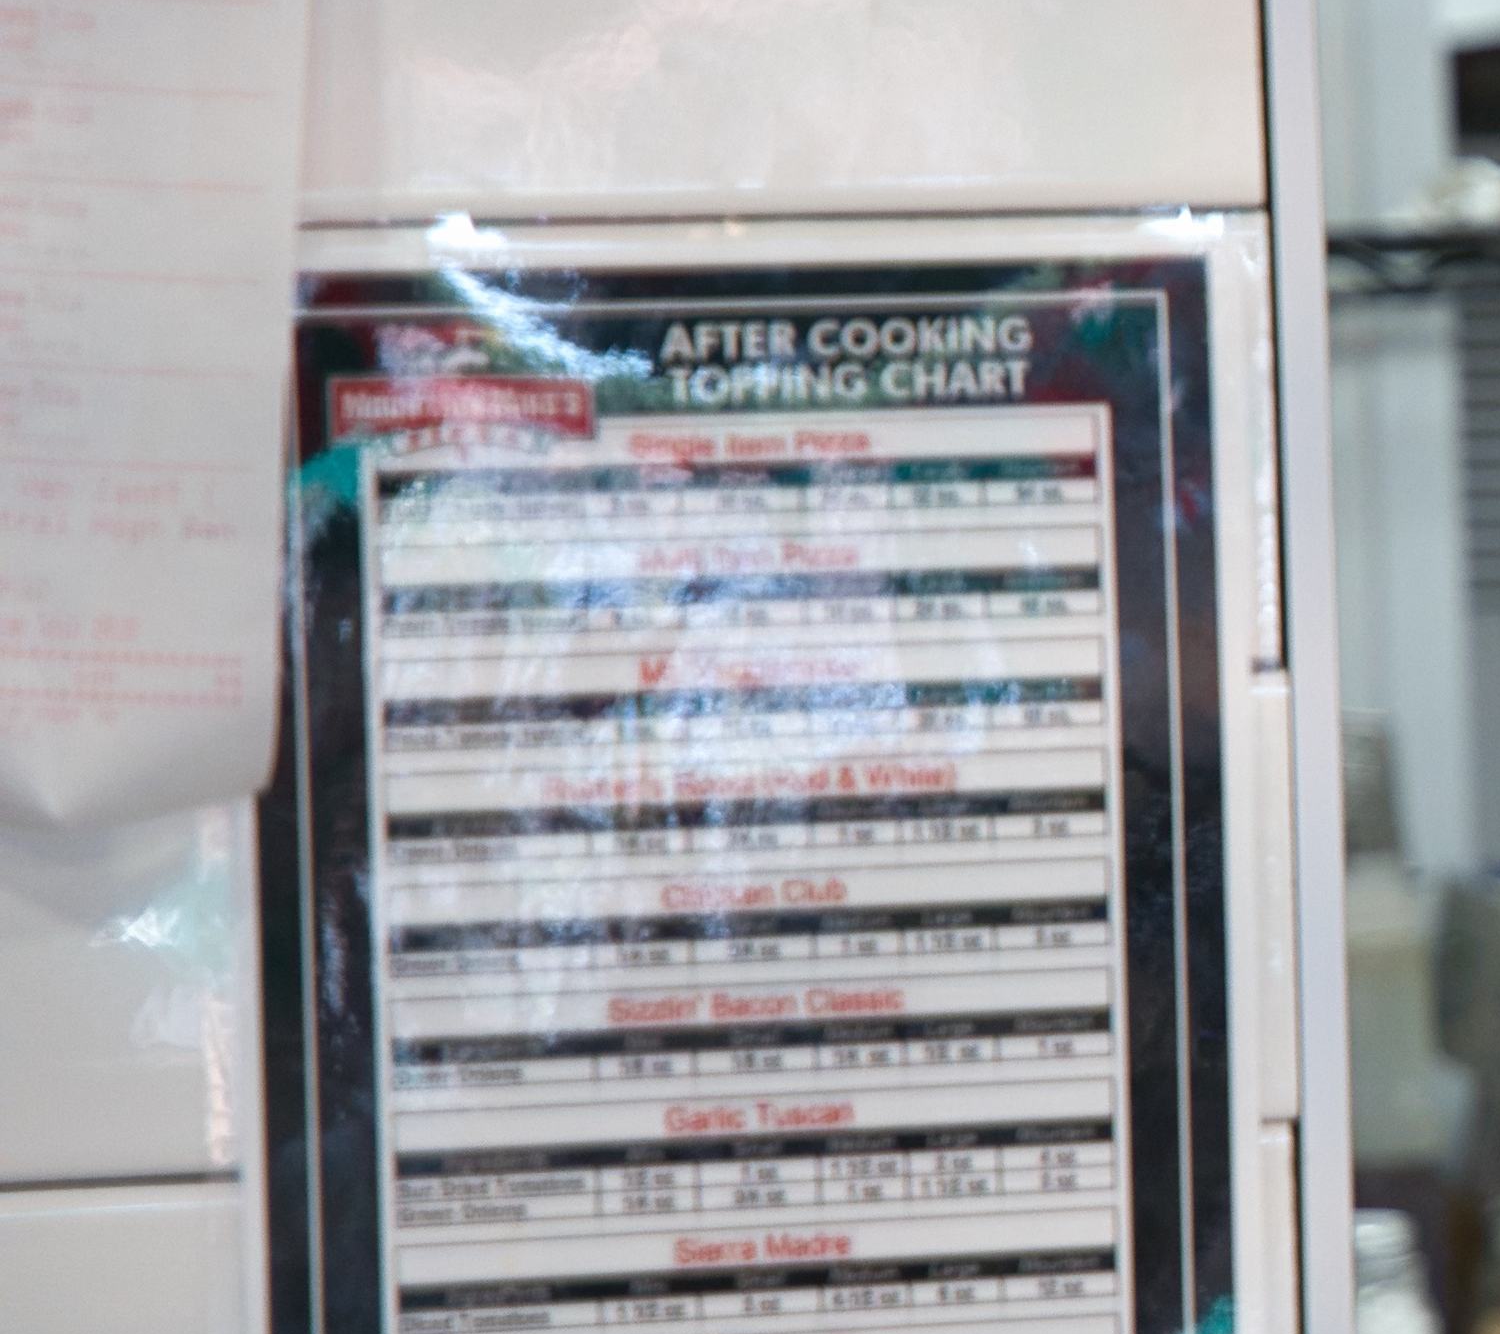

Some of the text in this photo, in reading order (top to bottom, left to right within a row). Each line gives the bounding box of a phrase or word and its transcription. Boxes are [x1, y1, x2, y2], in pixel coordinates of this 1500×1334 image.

[660, 316, 1032, 363] AFTER COOKING
[668, 358, 1027, 405] TOPPING CHART
[664, 1105, 747, 1134] Garlic
[764, 1231, 851, 1259] Madre
